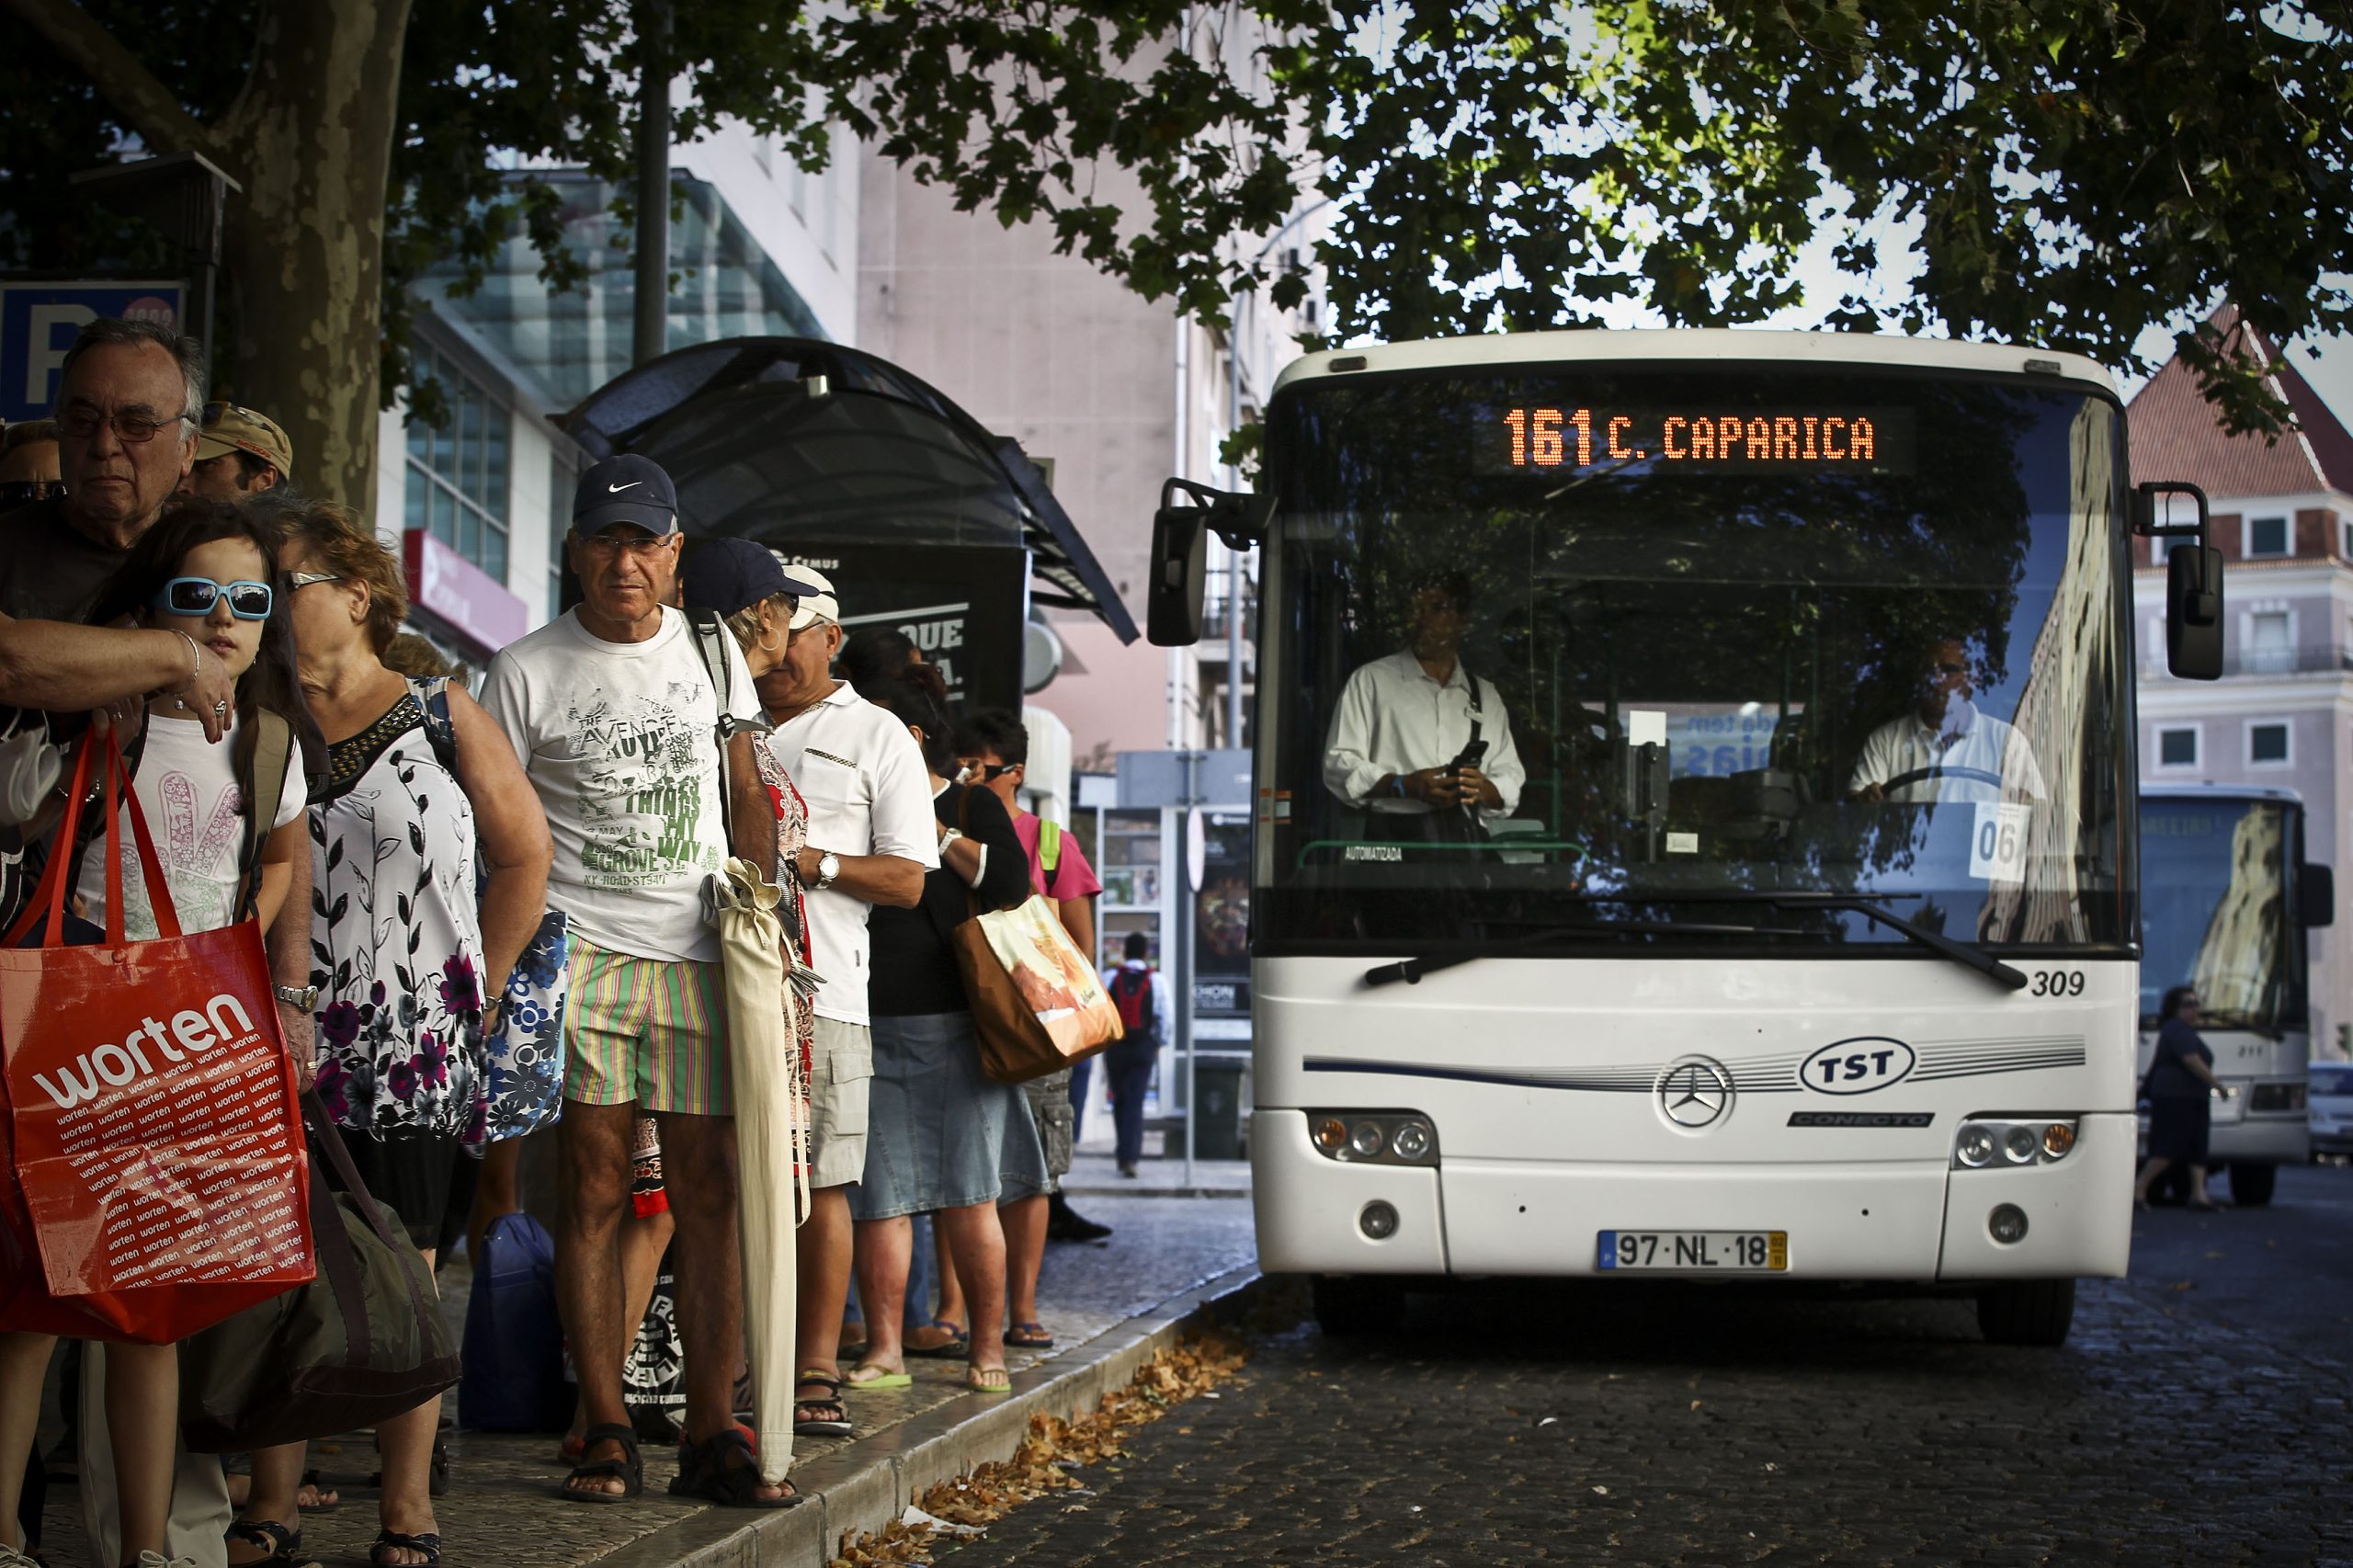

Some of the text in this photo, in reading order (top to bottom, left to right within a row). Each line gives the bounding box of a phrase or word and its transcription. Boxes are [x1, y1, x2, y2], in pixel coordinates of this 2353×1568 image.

[1504, 409, 1874, 466] 161 C. CAPARICA
[598, 848, 660, 873] GROVE
[1979, 821, 2016, 864] 06
[2030, 971, 2085, 996] 309
[32, 994, 255, 1109] worten
[57, 1033, 261, 1125] worten worten worten worten worten worten
[1817, 1050, 1894, 1083] TST
[61, 1046, 269, 1140] worten worten worten worten worten worten
[63, 1060, 276, 1153] worten worten worten worten worten worten
[69, 1074, 279, 1167] worten worten worten worten worten worten
[1793, 1113, 1927, 1127] CONECTO
[79, 1161, 109, 1178] worten
[111, 1147, 140, 1164] worten
[142, 1134, 175, 1151] worten
[180, 1120, 213, 1137] worten
[219, 1105, 250, 1123] worten
[88, 1173, 119, 1192] worten
[120, 1160, 148, 1176] worten
[149, 1147, 180, 1165] worten
[184, 1133, 216, 1151] worten
[221, 1119, 254, 1137] worten
[97, 1187, 126, 1206] worten
[129, 1175, 155, 1191] worten
[156, 1162, 187, 1180] worten
[191, 1148, 223, 1165] worten
[226, 1134, 258, 1151] worten
[105, 1202, 129, 1220] worten
[133, 1189, 163, 1207] worten
[164, 1177, 192, 1194] worten
[197, 1162, 231, 1180] worten
[233, 1147, 267, 1165] worten
[107, 1218, 132, 1235] worten
[136, 1205, 167, 1222] worten
[170, 1192, 198, 1210] worten
[202, 1176, 235, 1195] worten
[240, 1161, 274, 1179] worten
[108, 1233, 135, 1250] worten
[140, 1221, 170, 1237] worten
[175, 1207, 203, 1224] worten
[207, 1191, 242, 1210] worten
[245, 1176, 279, 1195] worten
[110, 1190, 286, 1267] worten worten worten worten worten
[113, 1205, 292, 1282] worten worten worten worten worten
[154, 1266, 188, 1281] worten
[190, 1251, 223, 1269] worten
[227, 1235, 261, 1255] worten
[265, 1220, 299, 1239] worten
[199, 1265, 231, 1280] worten
[233, 1250, 267, 1268] worten
[243, 1265, 275, 1281] worten
